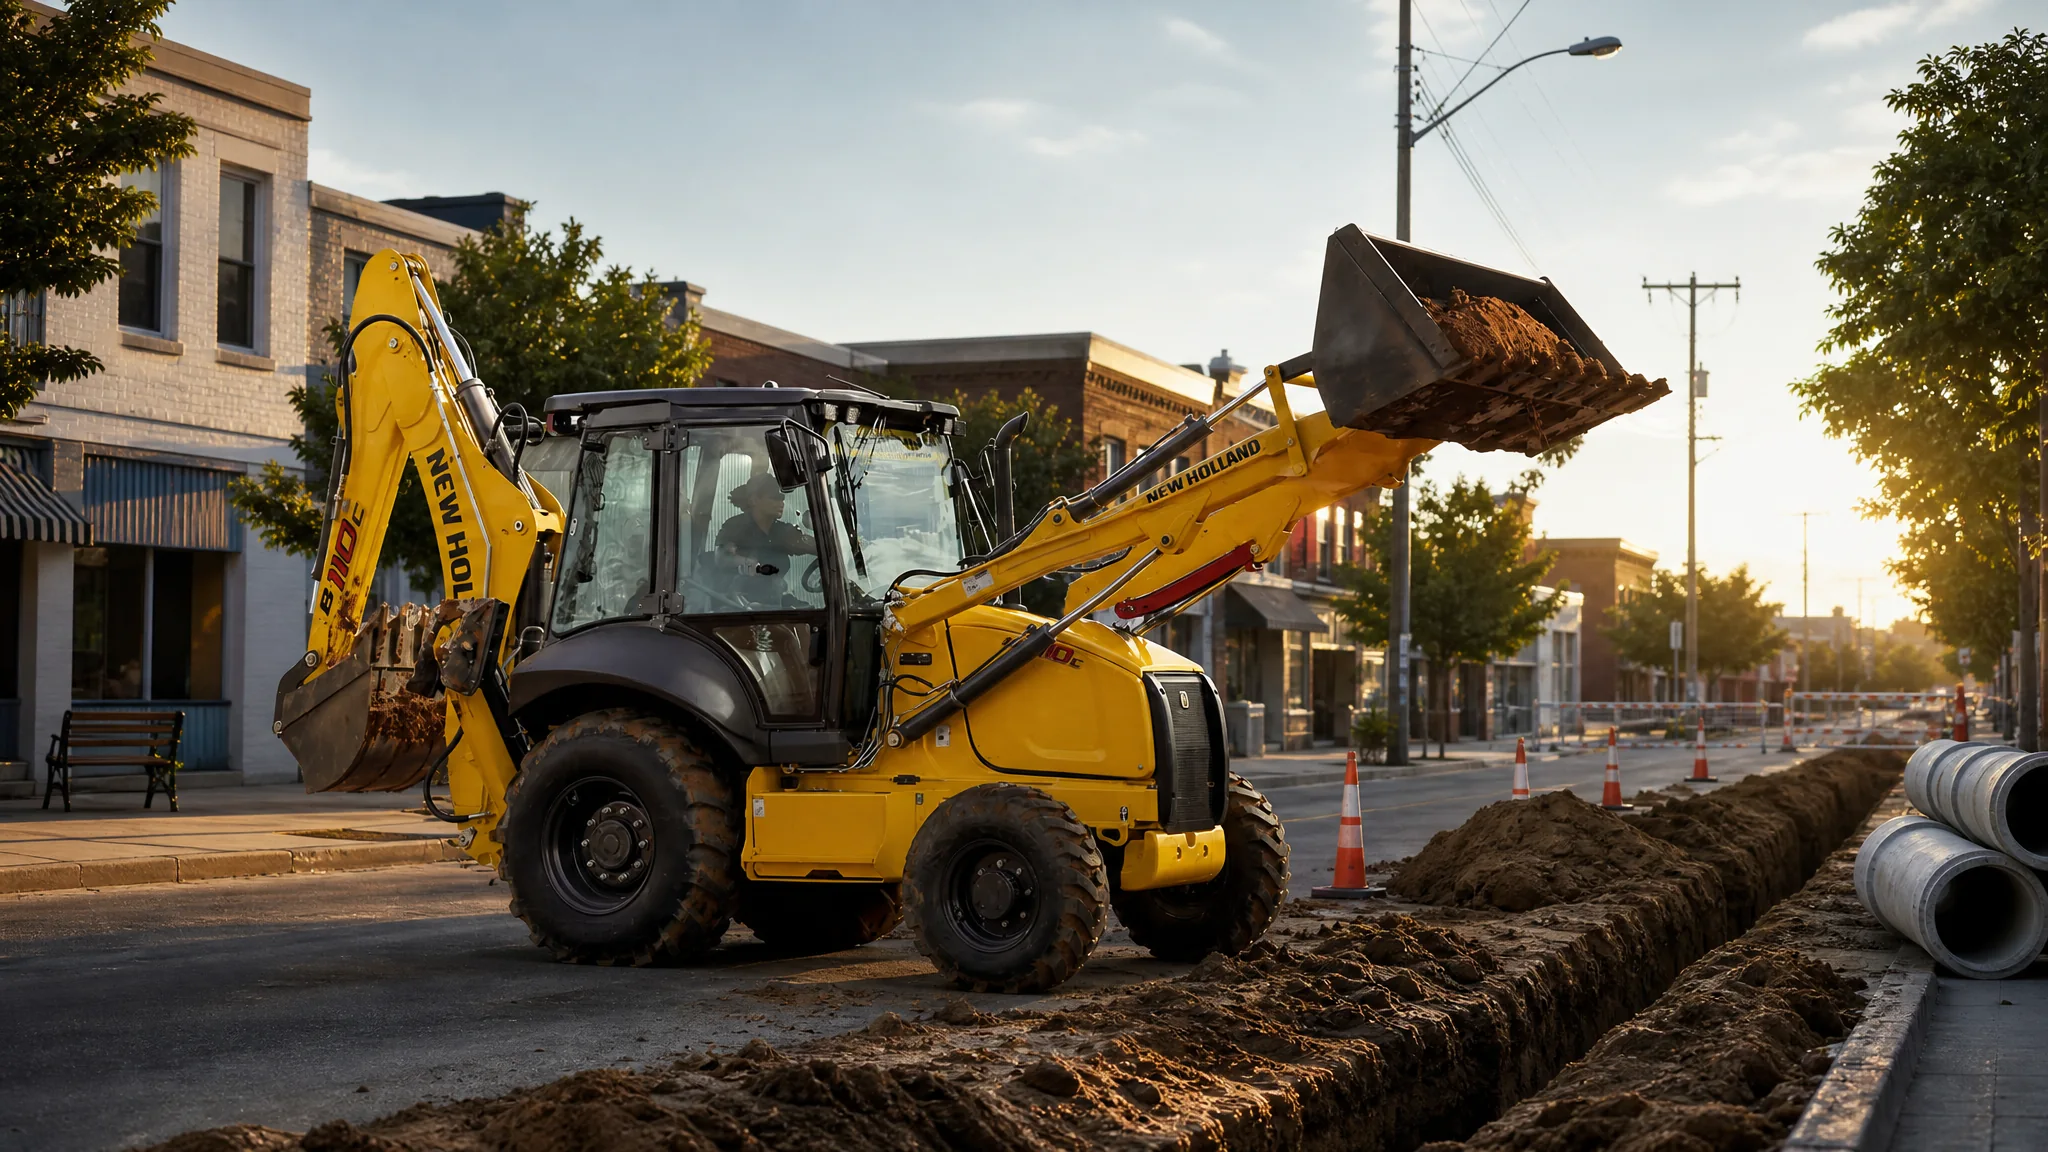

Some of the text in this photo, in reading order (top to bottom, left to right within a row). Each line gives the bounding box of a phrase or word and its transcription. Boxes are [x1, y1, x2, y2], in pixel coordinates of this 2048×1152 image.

[427, 447, 475, 600] NEW HOL
[1145, 439, 1261, 504] NEW HOLLAND
